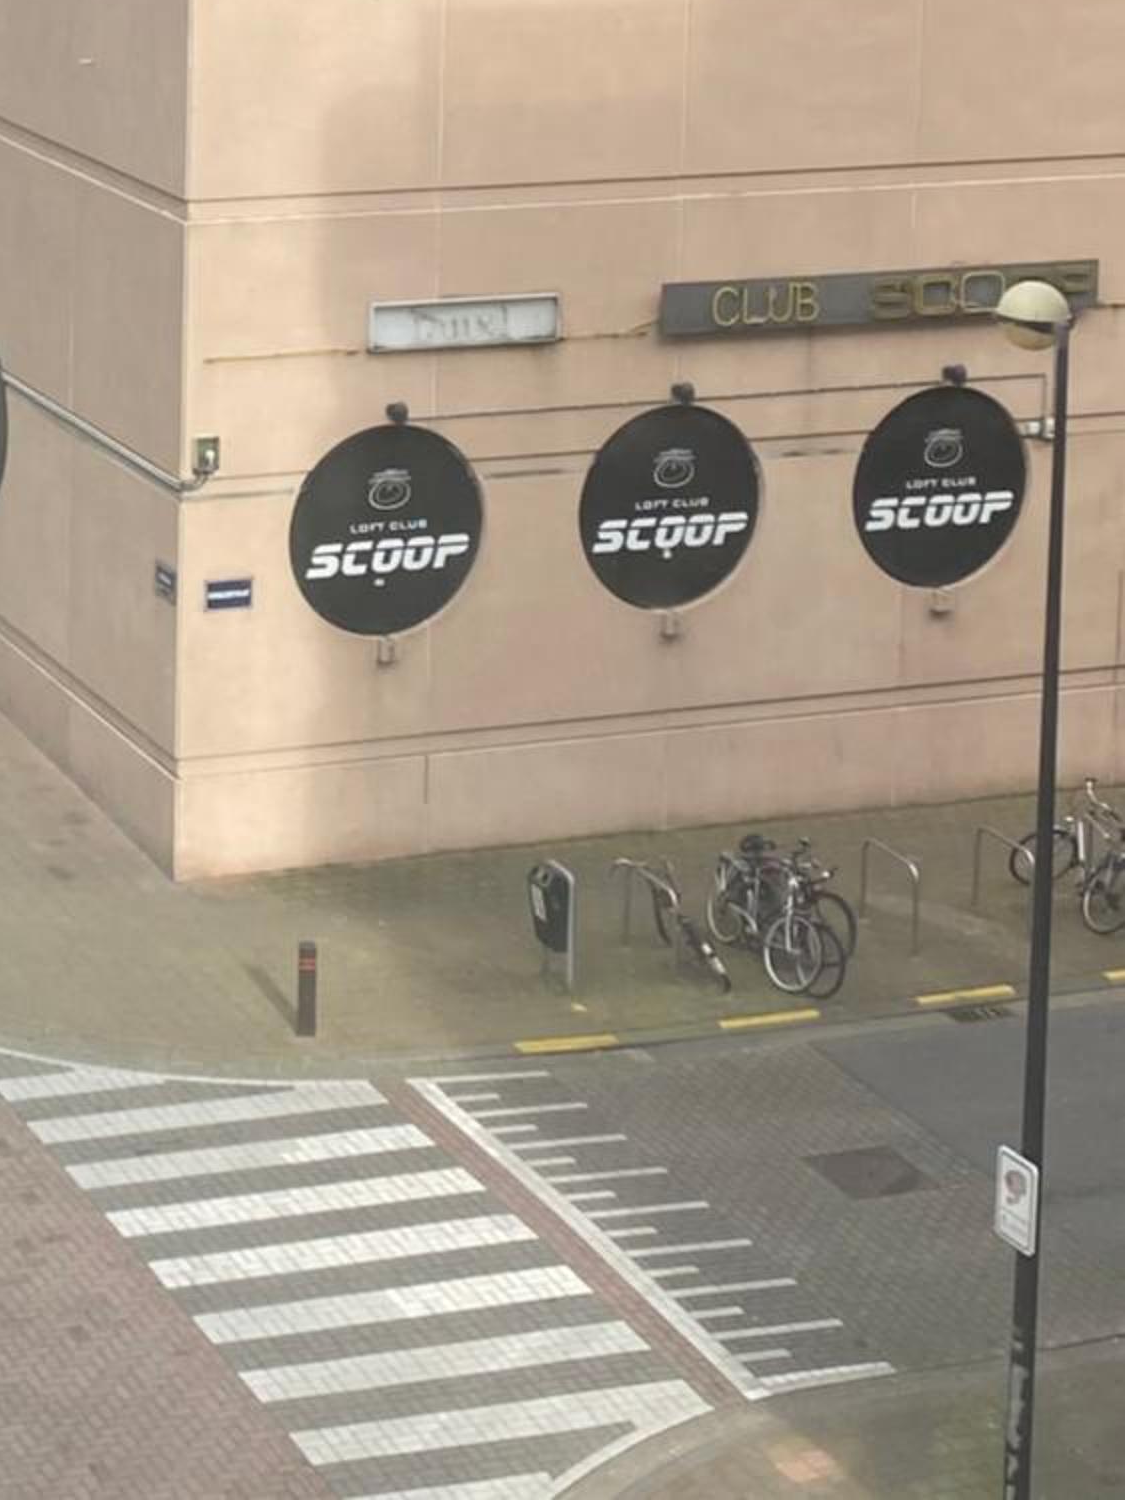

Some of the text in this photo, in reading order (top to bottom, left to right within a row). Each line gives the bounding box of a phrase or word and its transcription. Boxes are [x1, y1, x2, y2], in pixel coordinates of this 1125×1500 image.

[711, 281, 820, 327] CLUB
[672, 496, 710, 509] CLUB
[941, 476, 977, 487] CLUB
[389, 518, 428, 532] CLUB
[864, 490, 1014, 532] SCOOP
[592, 511, 748, 554] SCOOP
[305, 533, 470, 580] SCOOP
